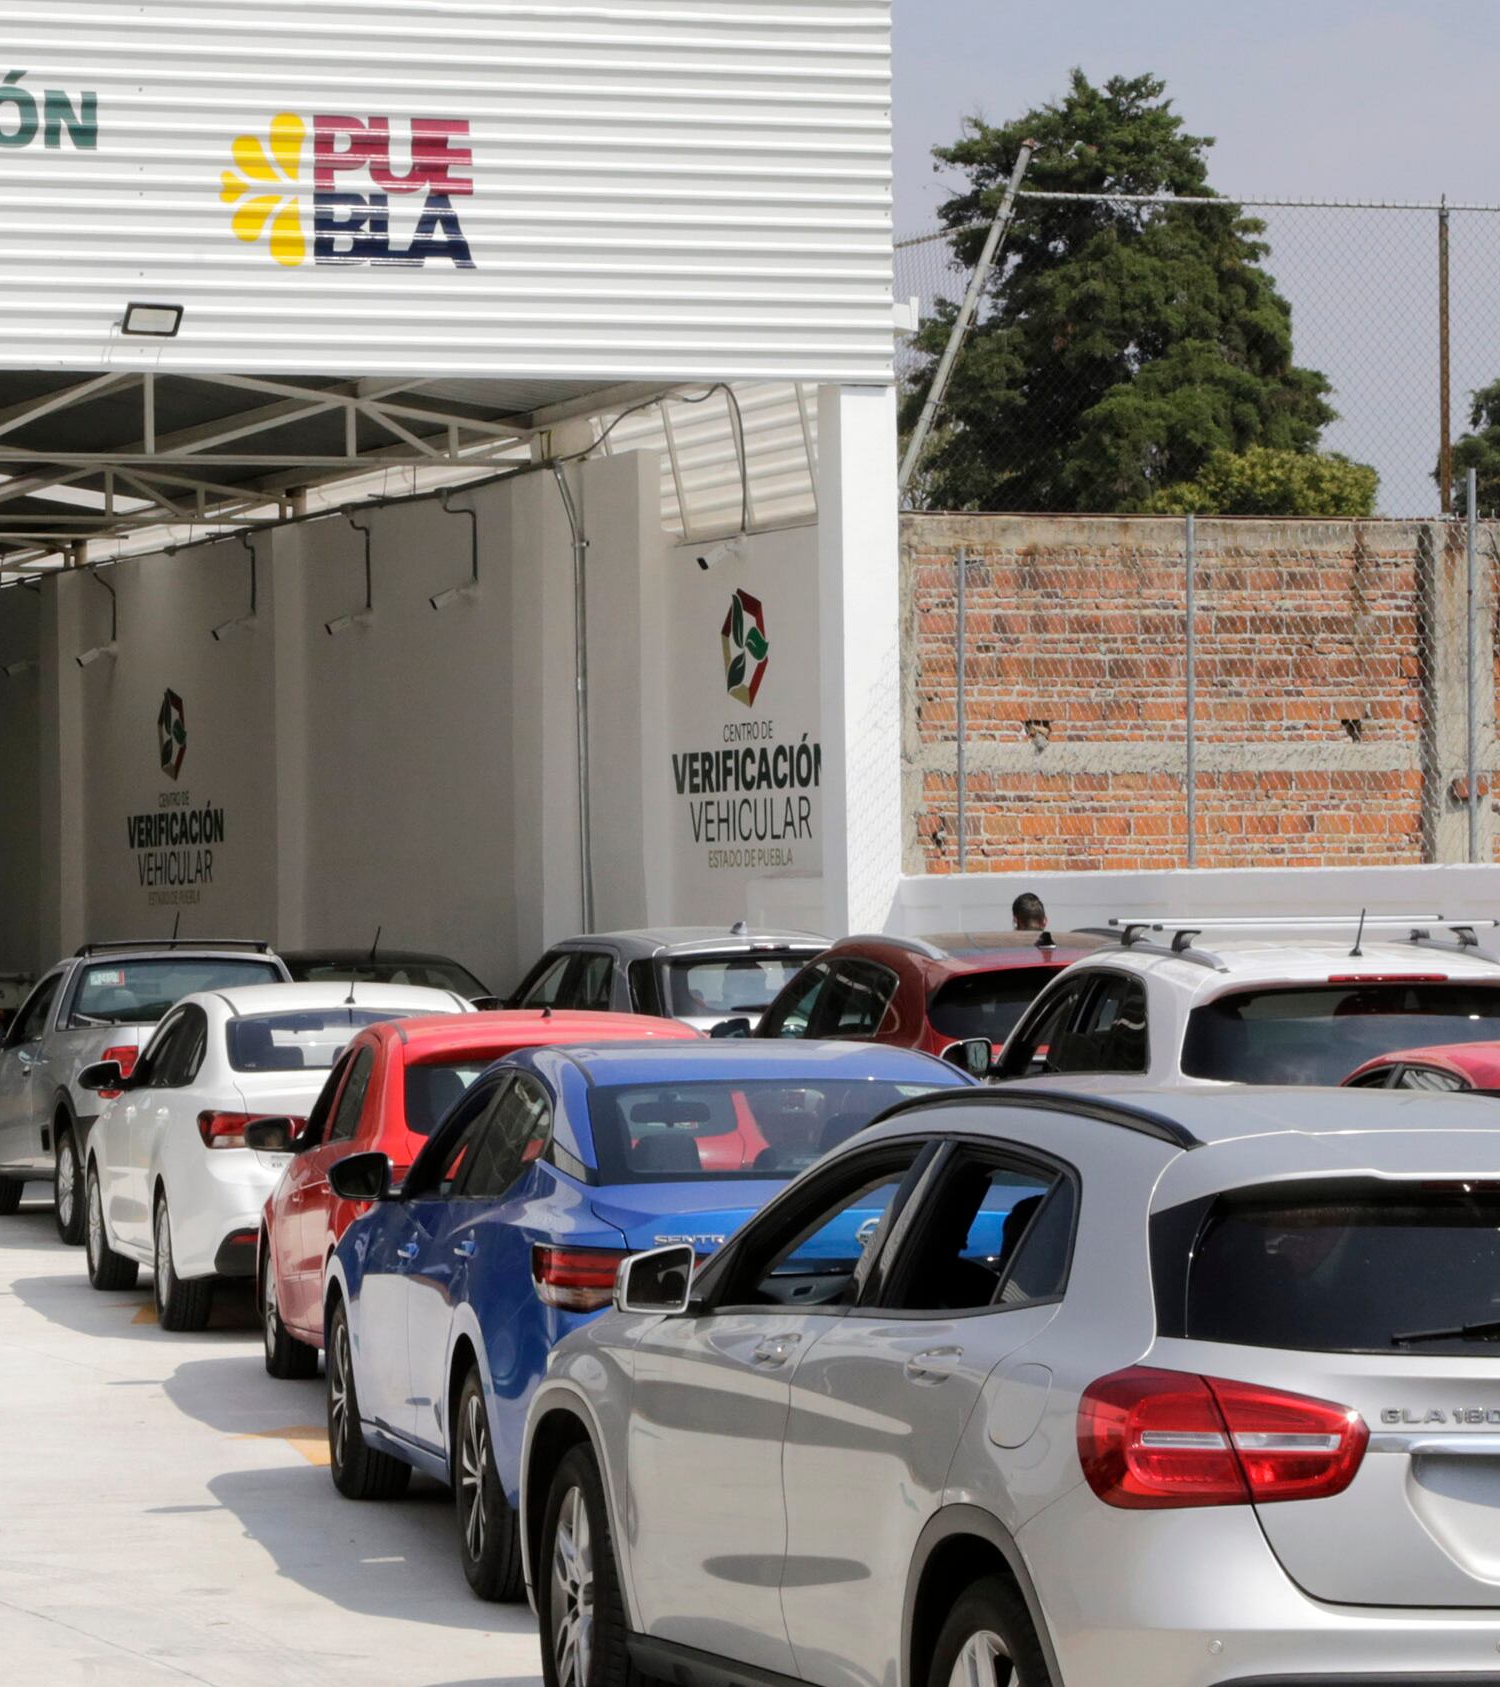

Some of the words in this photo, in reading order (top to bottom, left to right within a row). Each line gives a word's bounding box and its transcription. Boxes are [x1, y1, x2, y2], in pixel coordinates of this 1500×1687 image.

[313, 115, 474, 195] PUE
[313, 192, 477, 269] BLA
[723, 722, 758, 742] CENTRO
[761, 720, 773, 740] DE
[127, 800, 224, 849] VERIFICACIÓN
[690, 796, 812, 843] VEHICULAR
[138, 849, 213, 887] VEHICULAR
[708, 850, 742, 868] ESTADO
[744, 850, 755, 867] DE
[758, 849, 793, 866] PUEBLA
[1381, 1408, 1446, 1424] GLA
